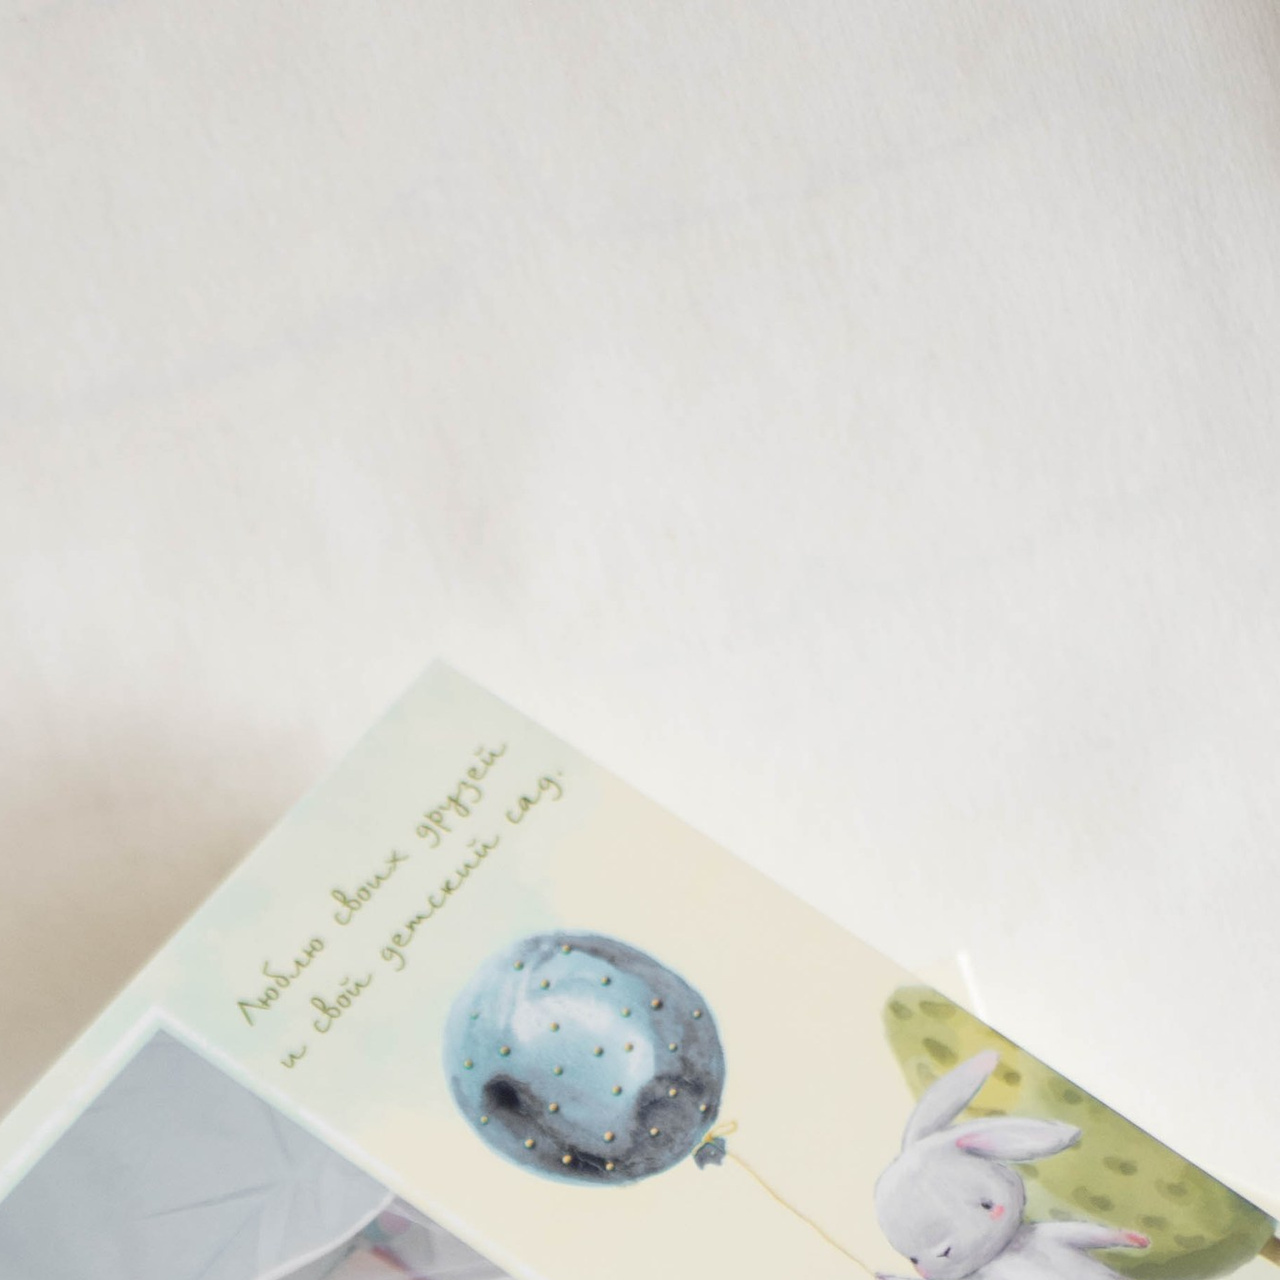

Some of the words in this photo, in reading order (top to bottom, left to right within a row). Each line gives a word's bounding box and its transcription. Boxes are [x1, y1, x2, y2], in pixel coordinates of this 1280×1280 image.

[236, 937, 325, 1027] Люблю
[332, 850, 408, 925] своих
[416, 744, 507, 847] друзей
[281, 1045, 307, 1069] и
[313, 974, 372, 1034] свой
[381, 836, 500, 971] детский
